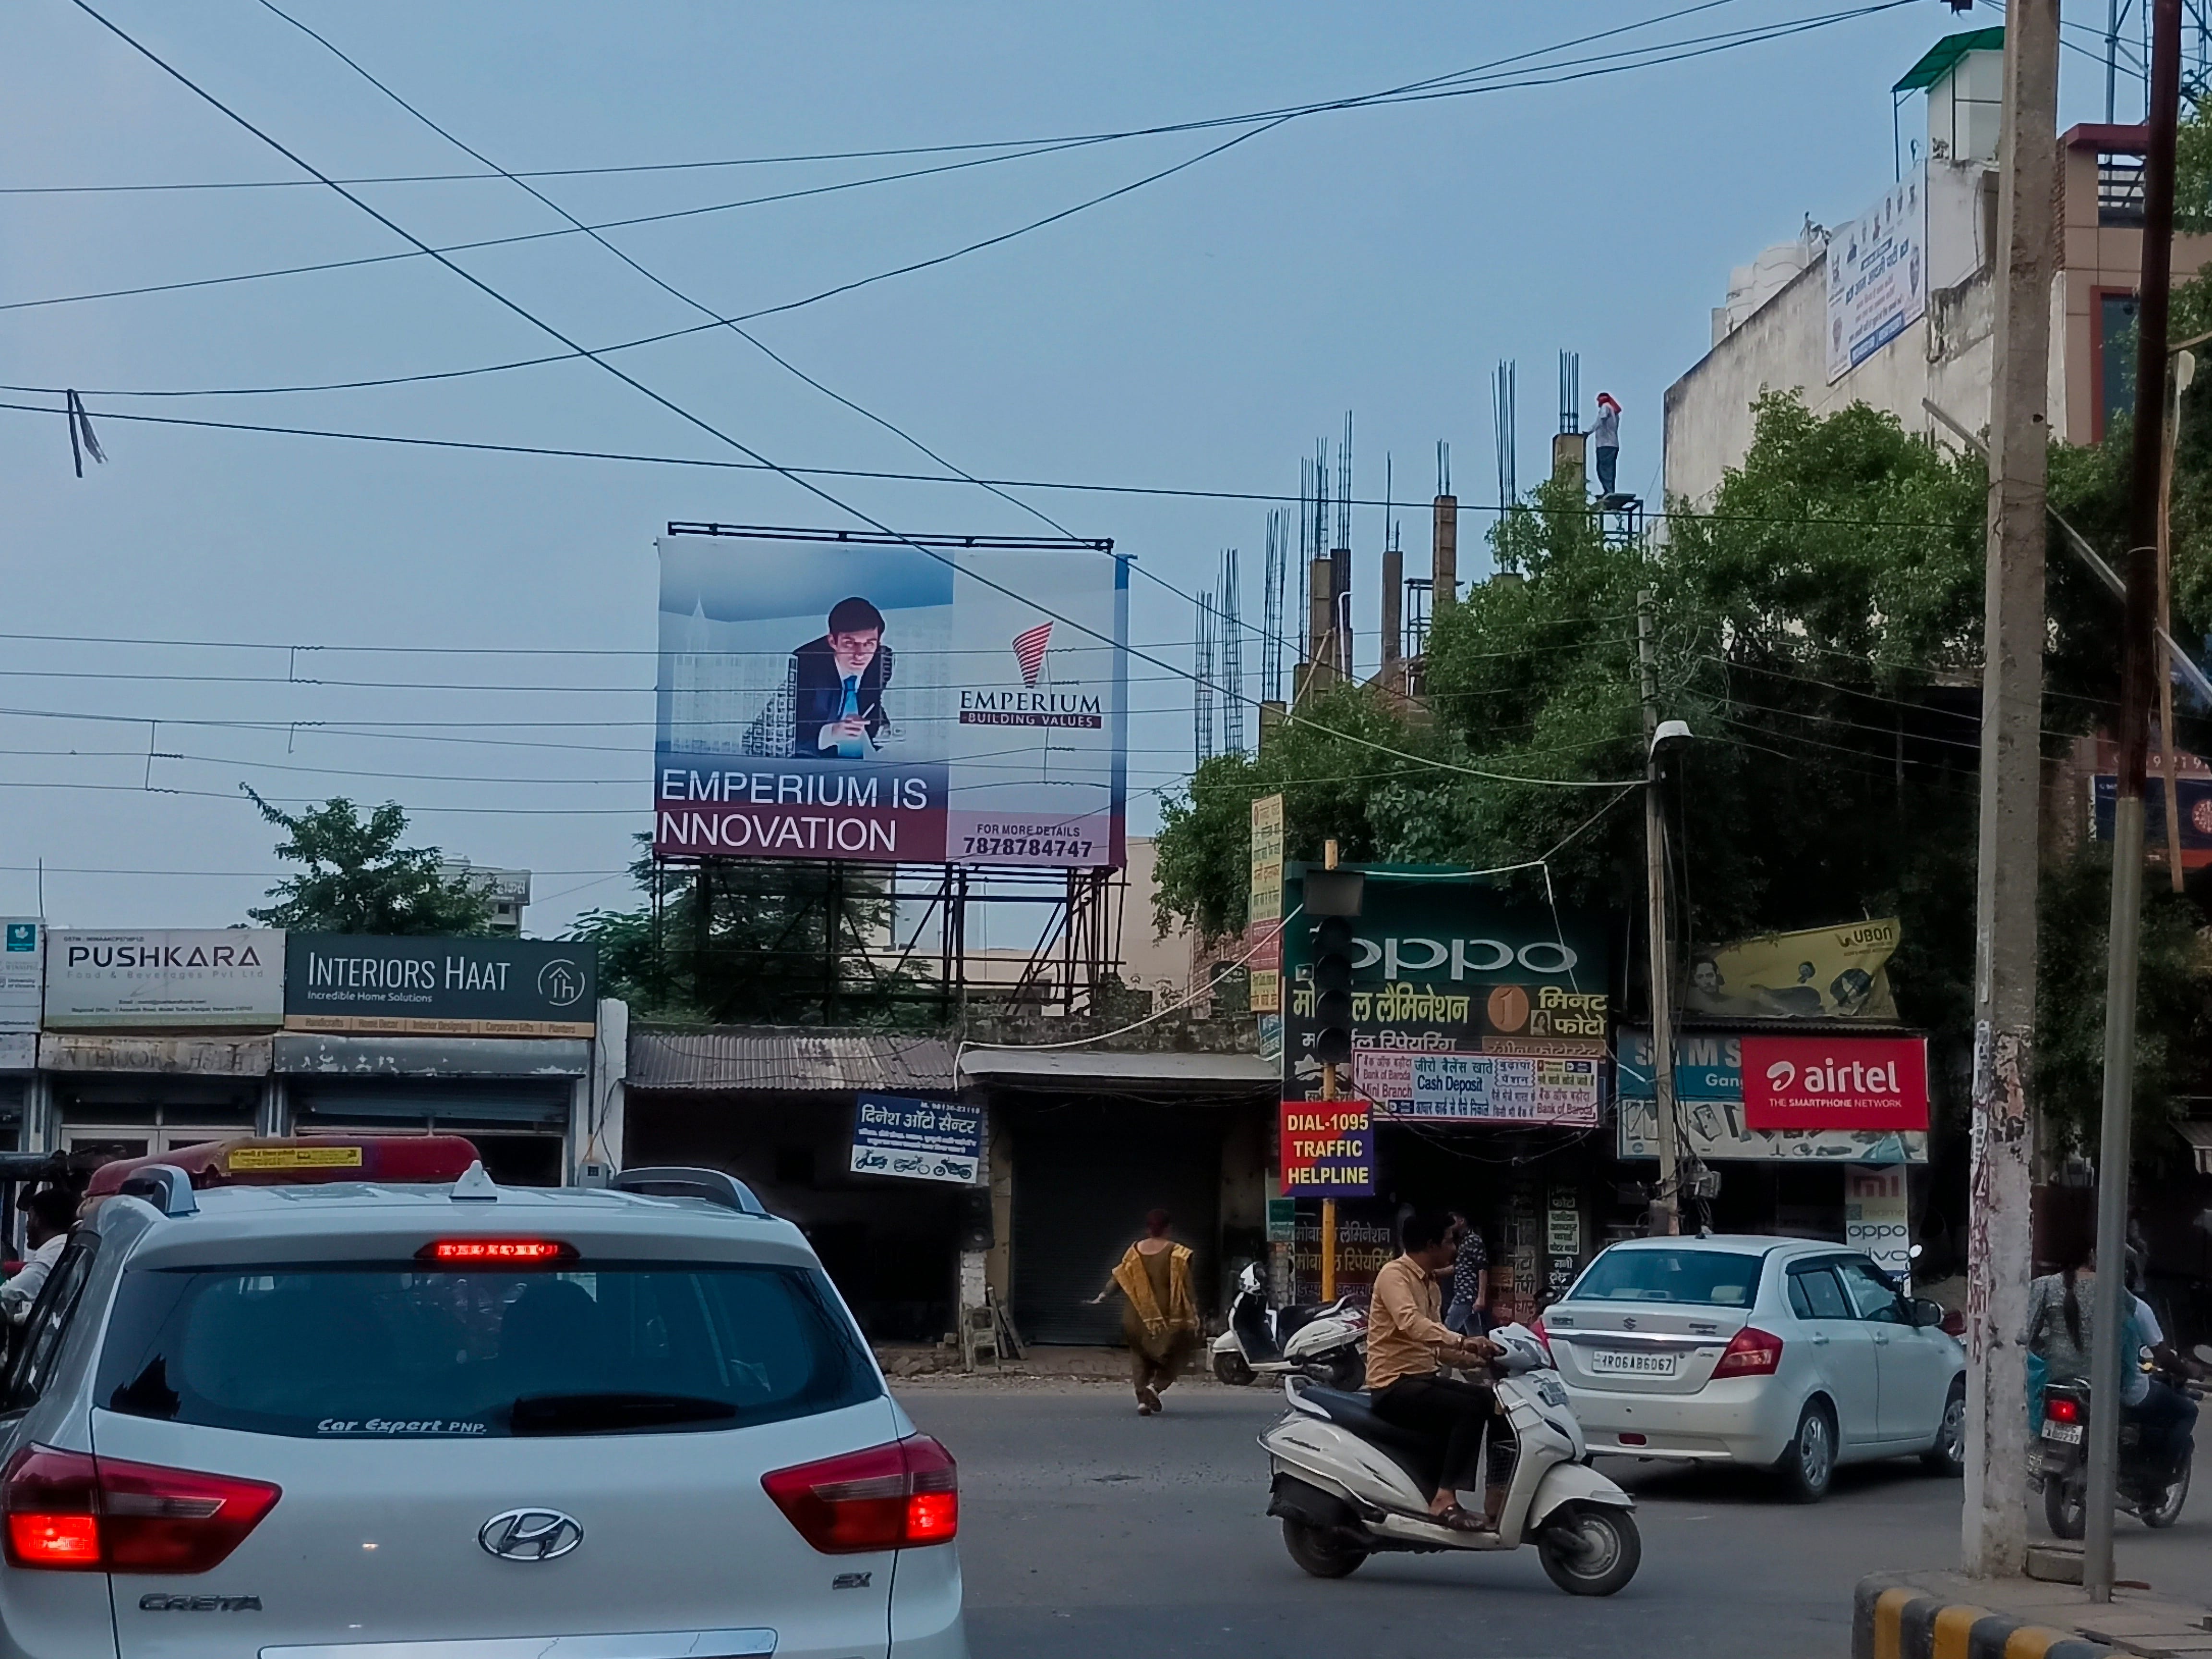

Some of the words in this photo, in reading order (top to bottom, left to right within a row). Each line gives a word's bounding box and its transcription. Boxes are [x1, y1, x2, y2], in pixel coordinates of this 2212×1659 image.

[961, 690, 1101, 713] EMPERIUM
[968, 712, 1035, 725] BUILDING
[1042, 715, 1093, 727] VALUES
[661, 769, 878, 808] EMPERIUM
[892, 778, 927, 810] IS
[977, 824, 999, 834] FOR
[1002, 825, 1034, 835] MORE
[1036, 826, 1080, 837] DETAILS
[963, 837, 1093, 858] 7878784747
[68, 946, 262, 968] PUSHKARA
[67, 971, 100, 979] Food
[110, 971, 117, 979] &
[127, 970, 203, 980] Beverages
[242, 970, 264, 978] Ltd
[309, 952, 436, 989] INTERIORS
[445, 956, 511, 991] HAAT
[307, 990, 356, 1000] Incredible
[357, 992, 385, 1001] Home
[387, 992, 433, 1003] Solutions
[1418, 1075, 1443, 1091] Cash
[1445, 1076, 1483, 1095] Deposit
[1804, 1058, 1901, 1094] airtel
[1382, 1084, 1412, 1098] Branch
[1769, 1098, 1787, 1106] THE
[1789, 1098, 1852, 1107] SMARTPHONE
[1854, 1099, 1902, 1107] NETWORK
[861, 1104, 901, 1126] दिनेश
[903, 1110, 936, 1130] ऑटो
[1293, 1140, 1363, 1157] TRAFFIC
[1287, 1166, 1369, 1184] HELPLINE
[1848, 1225, 1907, 1239] oppo
[317, 1418, 358, 1431] Car
[365, 1418, 443, 1434] Expert
[139, 1593, 263, 1611] CRETA
